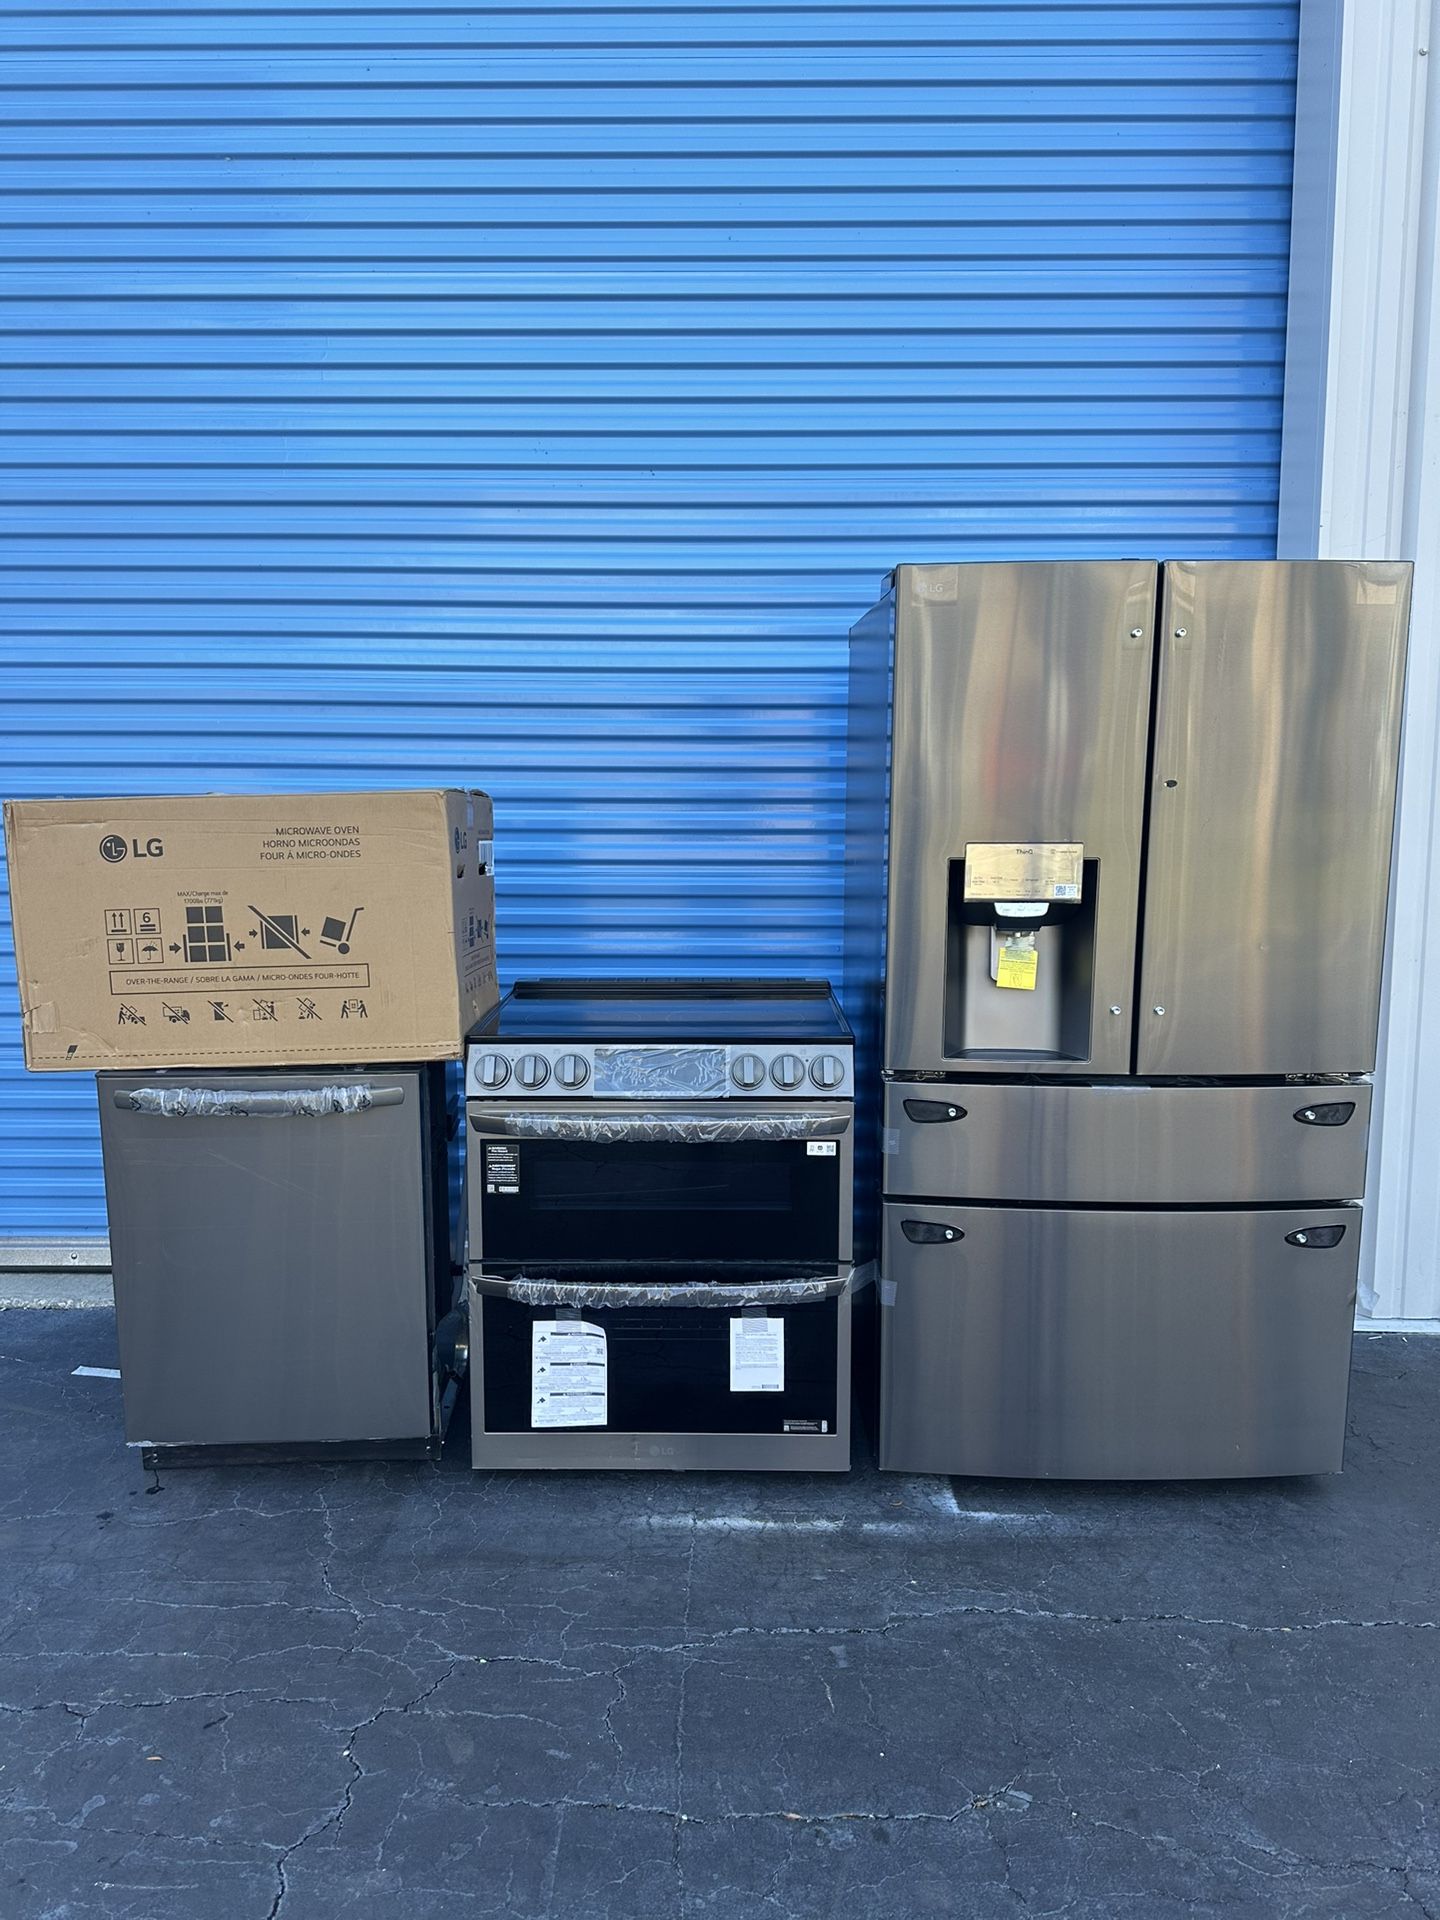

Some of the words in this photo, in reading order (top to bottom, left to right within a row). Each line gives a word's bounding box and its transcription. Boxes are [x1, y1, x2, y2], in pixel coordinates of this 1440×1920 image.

[929, 583, 944, 593] LG
[275, 826, 332, 836] MICROWAVE
[333, 825, 360, 835] OVEN
[132, 837, 164, 858] LG
[262, 839, 296, 848] HORNO
[298, 837, 361, 847] MICROONDAS
[260, 851, 285, 860] FOUR
[296, 849, 361, 859] MICRO-ONDES
[143, 912, 151, 923] 6
[125, 976, 189, 986] OVER-THE-RANGE
[195, 975, 220, 984] SOBRE
[221, 975, 232, 983] LA
[232, 974, 256, 983] GAMA
[262, 973, 314, 982] MICRO-ONDES
[314, 971, 360, 980] FOUR-HOTTE
